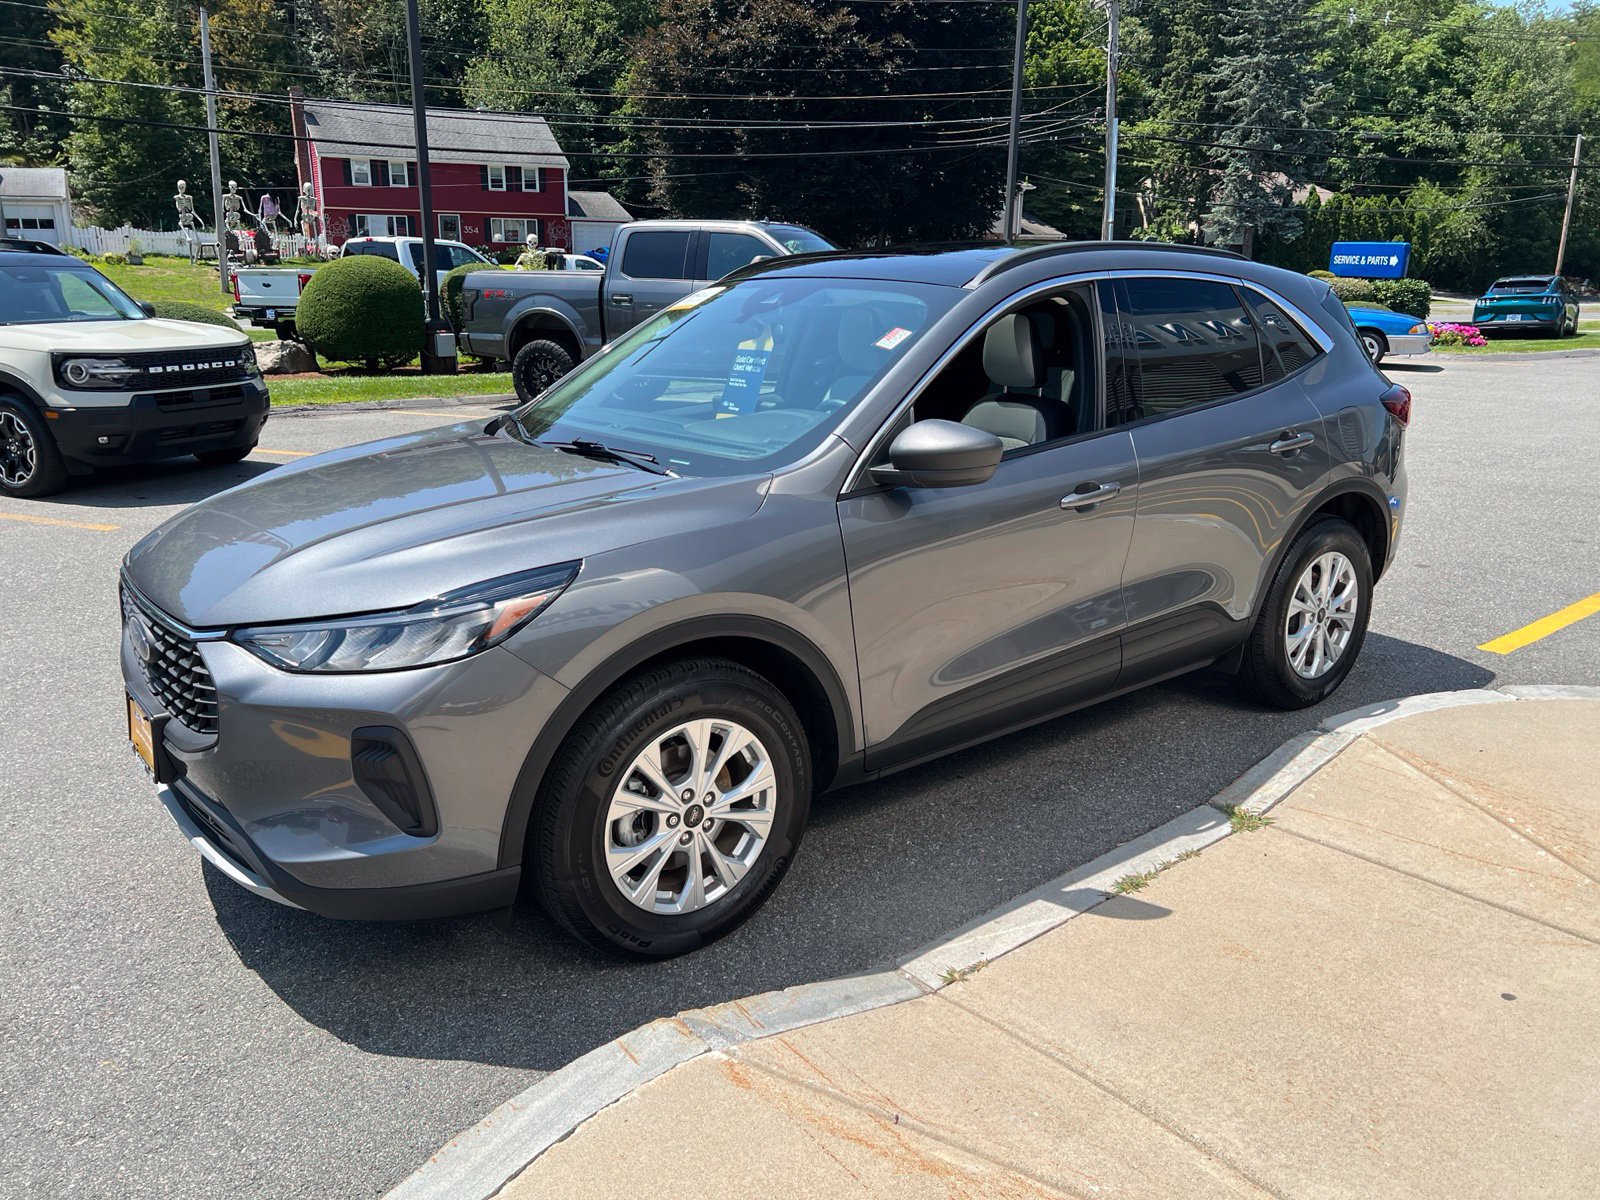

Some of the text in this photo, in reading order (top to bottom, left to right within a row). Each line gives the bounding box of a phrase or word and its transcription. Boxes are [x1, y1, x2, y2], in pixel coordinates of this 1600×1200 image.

[463, 226, 479, 234] 354
[1333, 254, 1389, 266] SERVICE & PARTS
[483, 289, 514, 299] FX4
[148, 360, 236, 374] BRONCO
[597, 700, 673, 778] Continental
